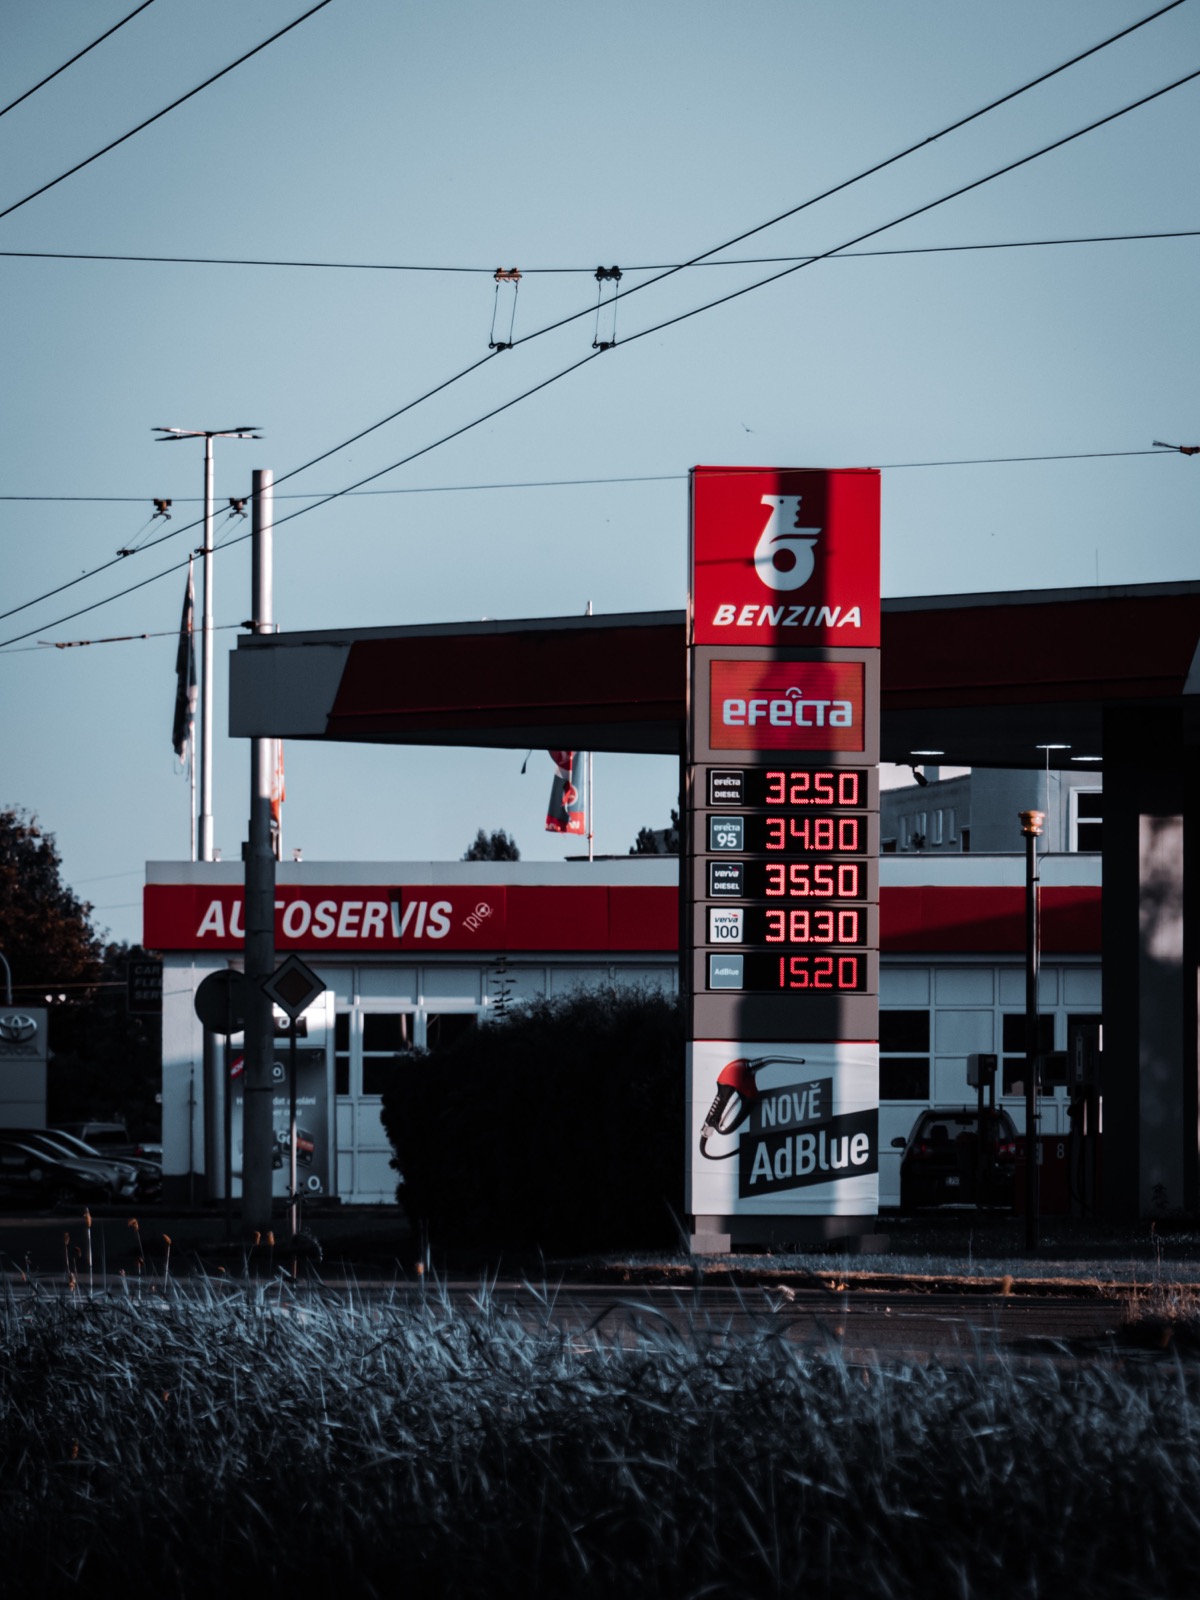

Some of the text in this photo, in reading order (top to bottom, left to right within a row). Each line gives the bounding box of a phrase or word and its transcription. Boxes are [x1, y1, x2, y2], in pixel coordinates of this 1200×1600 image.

[712, 604, 862, 628] BENZINA
[722, 697, 853, 727] efecta
[714, 790, 740, 798] DIESEL
[766, 772, 858, 805] 32.50
[717, 833, 737, 847] 95
[766, 818, 858, 850] 34.80
[714, 868, 739, 878] verva
[765, 864, 858, 897] 35.50
[714, 882, 740, 890] DIESEL
[196, 900, 452, 939] AUOSERVIS
[714, 915, 739, 923] verva
[765, 910, 858, 943] 38.30
[714, 925, 739, 938] 100
[714, 968, 740, 976] AdBlue
[779, 957, 858, 988] 15.20
[749, 1131, 870, 1185] AdBlue
[1056, 1142, 1065, 1159] 8
